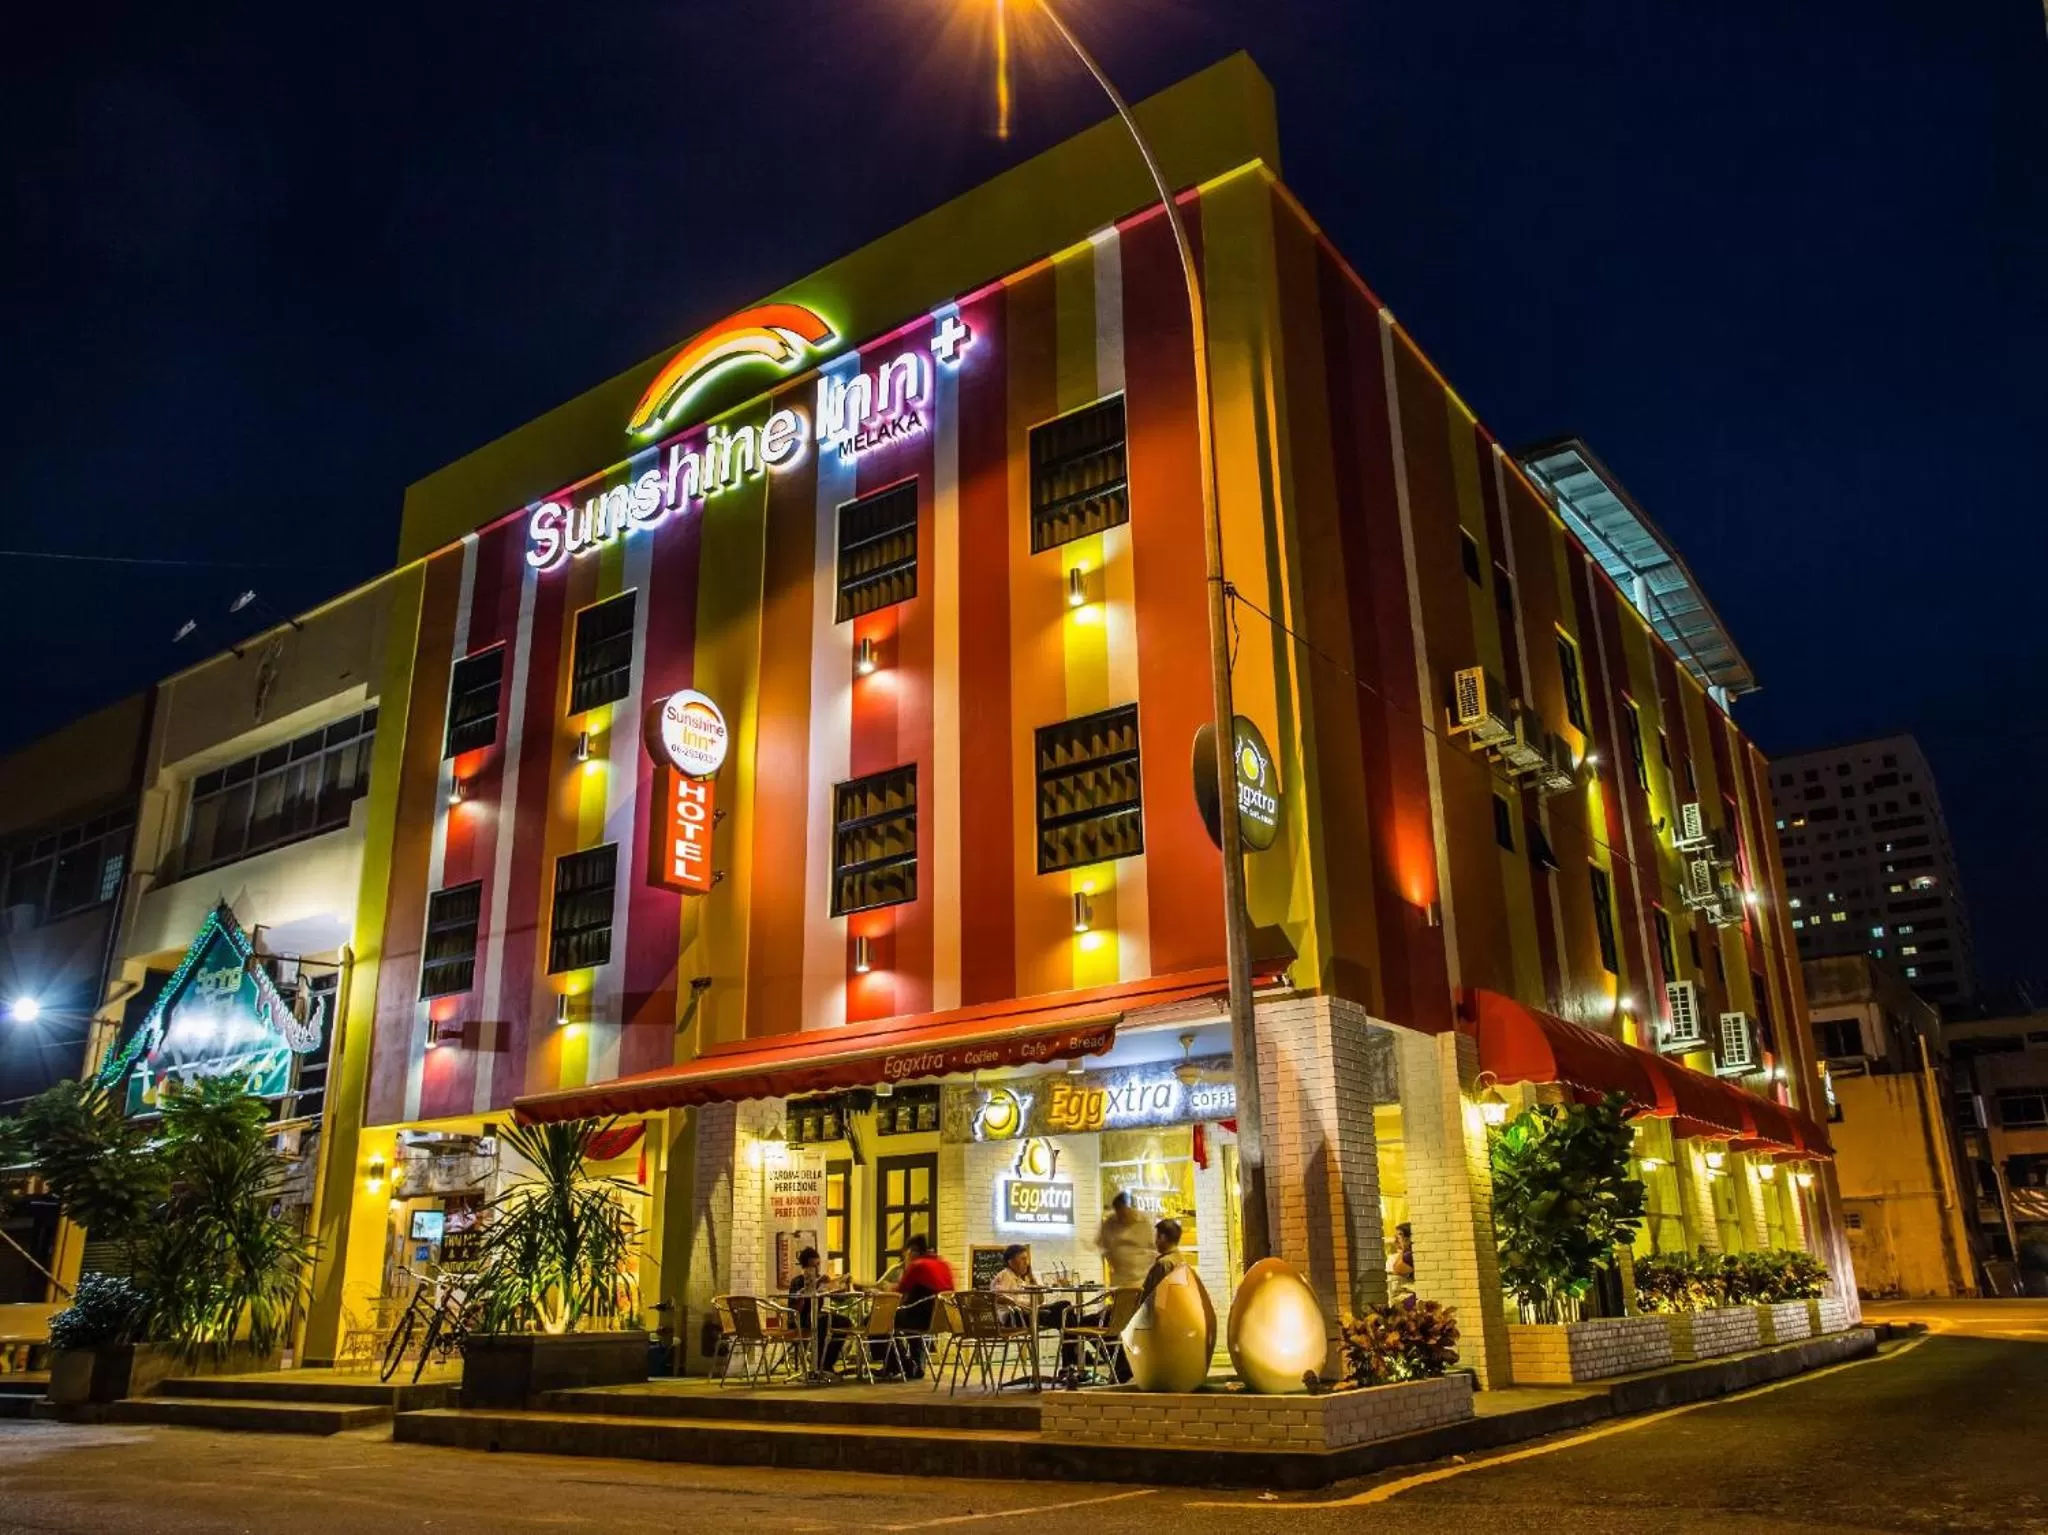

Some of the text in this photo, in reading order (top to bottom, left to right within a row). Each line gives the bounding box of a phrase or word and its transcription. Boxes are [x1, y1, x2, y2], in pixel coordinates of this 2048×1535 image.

[838, 409, 924, 460] MELAKA
[525, 408, 803, 570] Sunshine
[667, 705, 725, 737] Sunshine
[673, 780, 707, 882] HOTEL
[884, 1034, 1106, 1077] Eggxtra Coffee Cafe Bread
[1049, 1081, 1236, 1126] Eggxtra COFFE
[1011, 1182, 1073, 1213] Eggxtra
